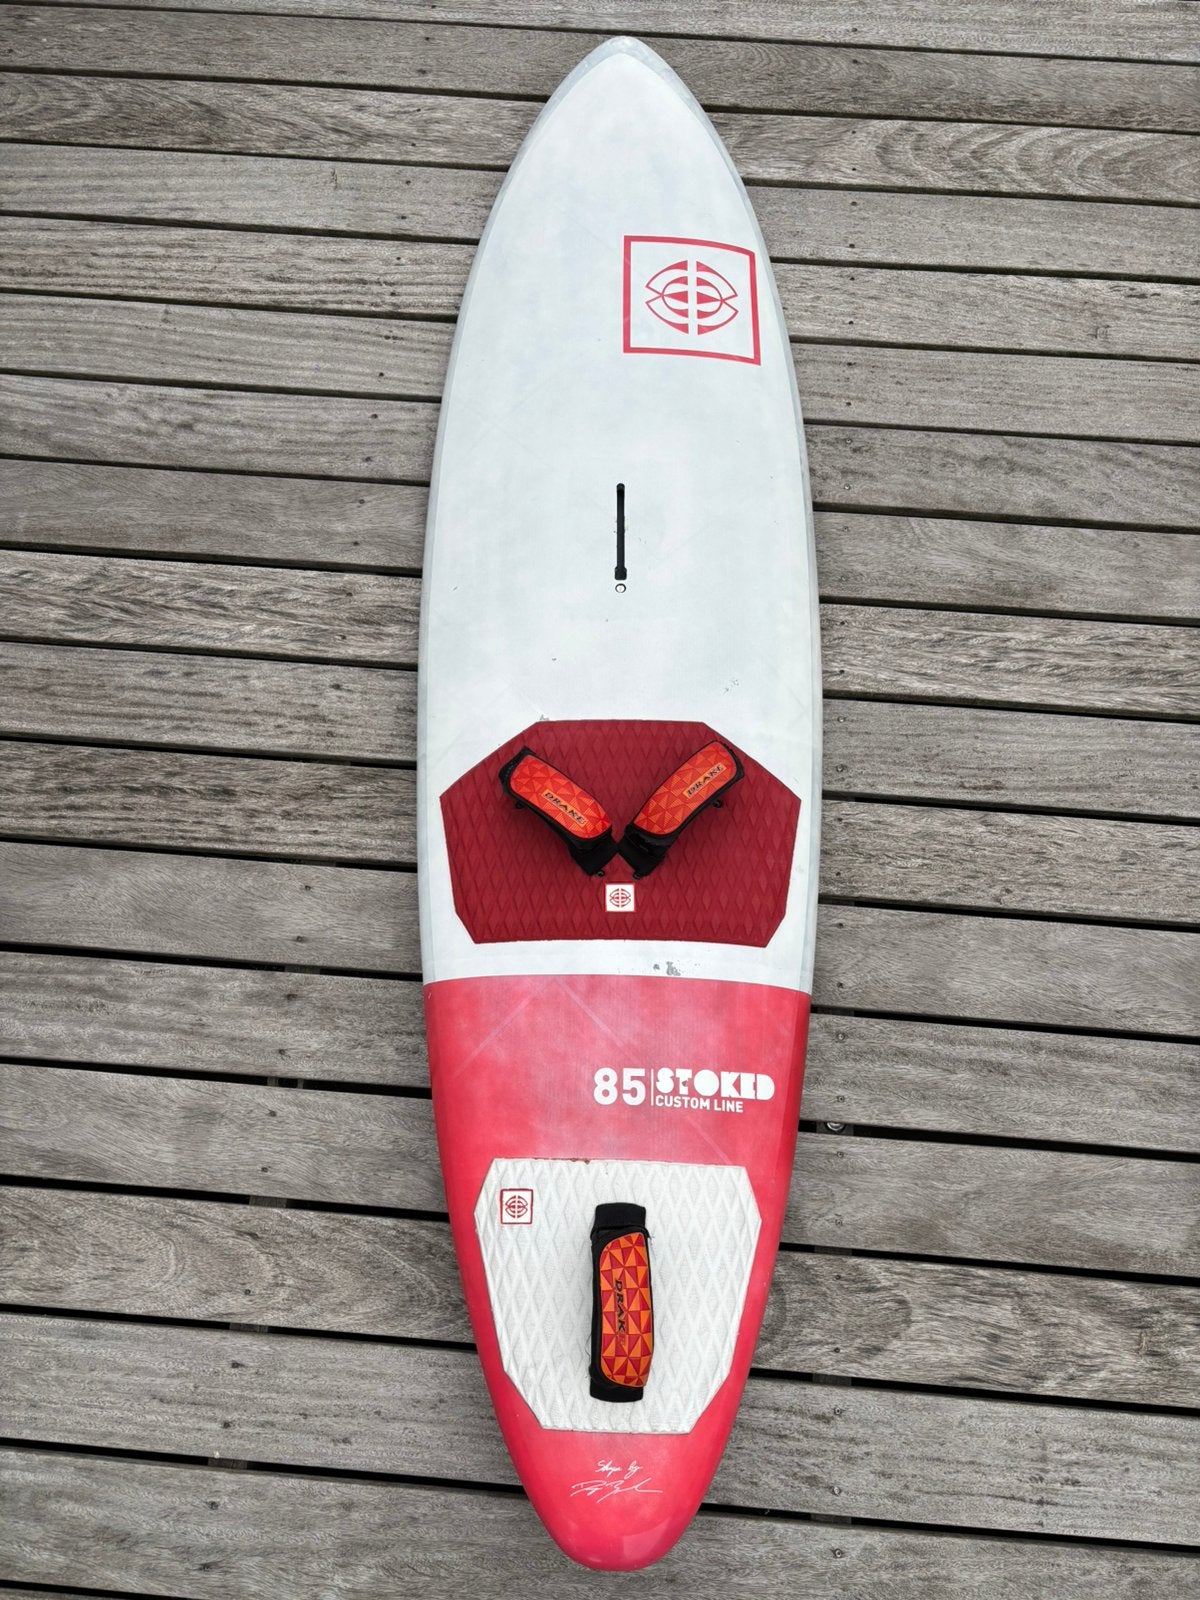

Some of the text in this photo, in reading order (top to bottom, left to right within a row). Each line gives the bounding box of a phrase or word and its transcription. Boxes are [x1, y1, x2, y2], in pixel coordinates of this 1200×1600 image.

[686, 764, 724, 797] DRAKE
[544, 791, 586, 825] DRAKE
[593, 1067, 775, 1106] 85 STOKED
[655, 1095, 744, 1113] CUSTOM LINE
